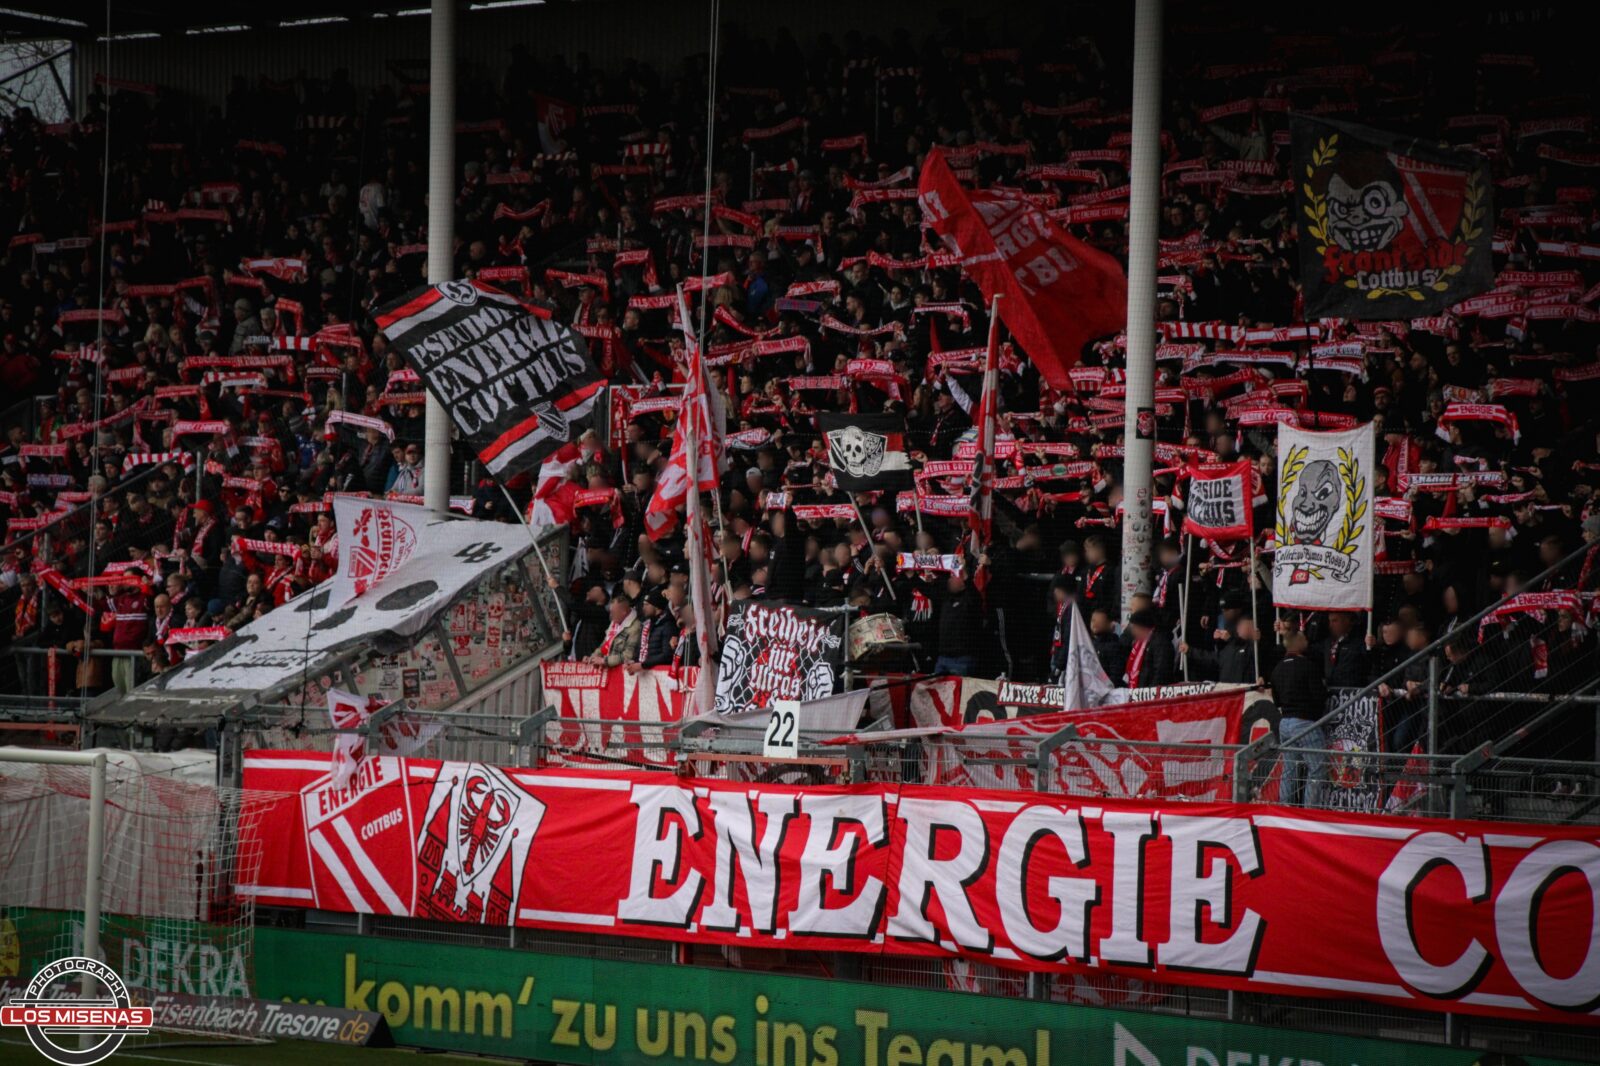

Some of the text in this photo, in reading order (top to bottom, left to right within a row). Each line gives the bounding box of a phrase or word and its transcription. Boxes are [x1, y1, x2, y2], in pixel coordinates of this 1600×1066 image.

[1459, 404, 1494, 415] ENERGIE
[768, 710, 795, 748] 22
[319, 756, 384, 816] ENERGIE
[361, 808, 404, 841] COTTBUS
[617, 784, 1267, 978] ENERGIE
[121, 938, 251, 999] DEKRA
[259, 1004, 370, 1043] Tresore.de
[551, 999, 617, 1051] zu
[636, 1007, 738, 1064] uns
[756, 994, 840, 1066] ins
[855, 1008, 1050, 1066] Team!
